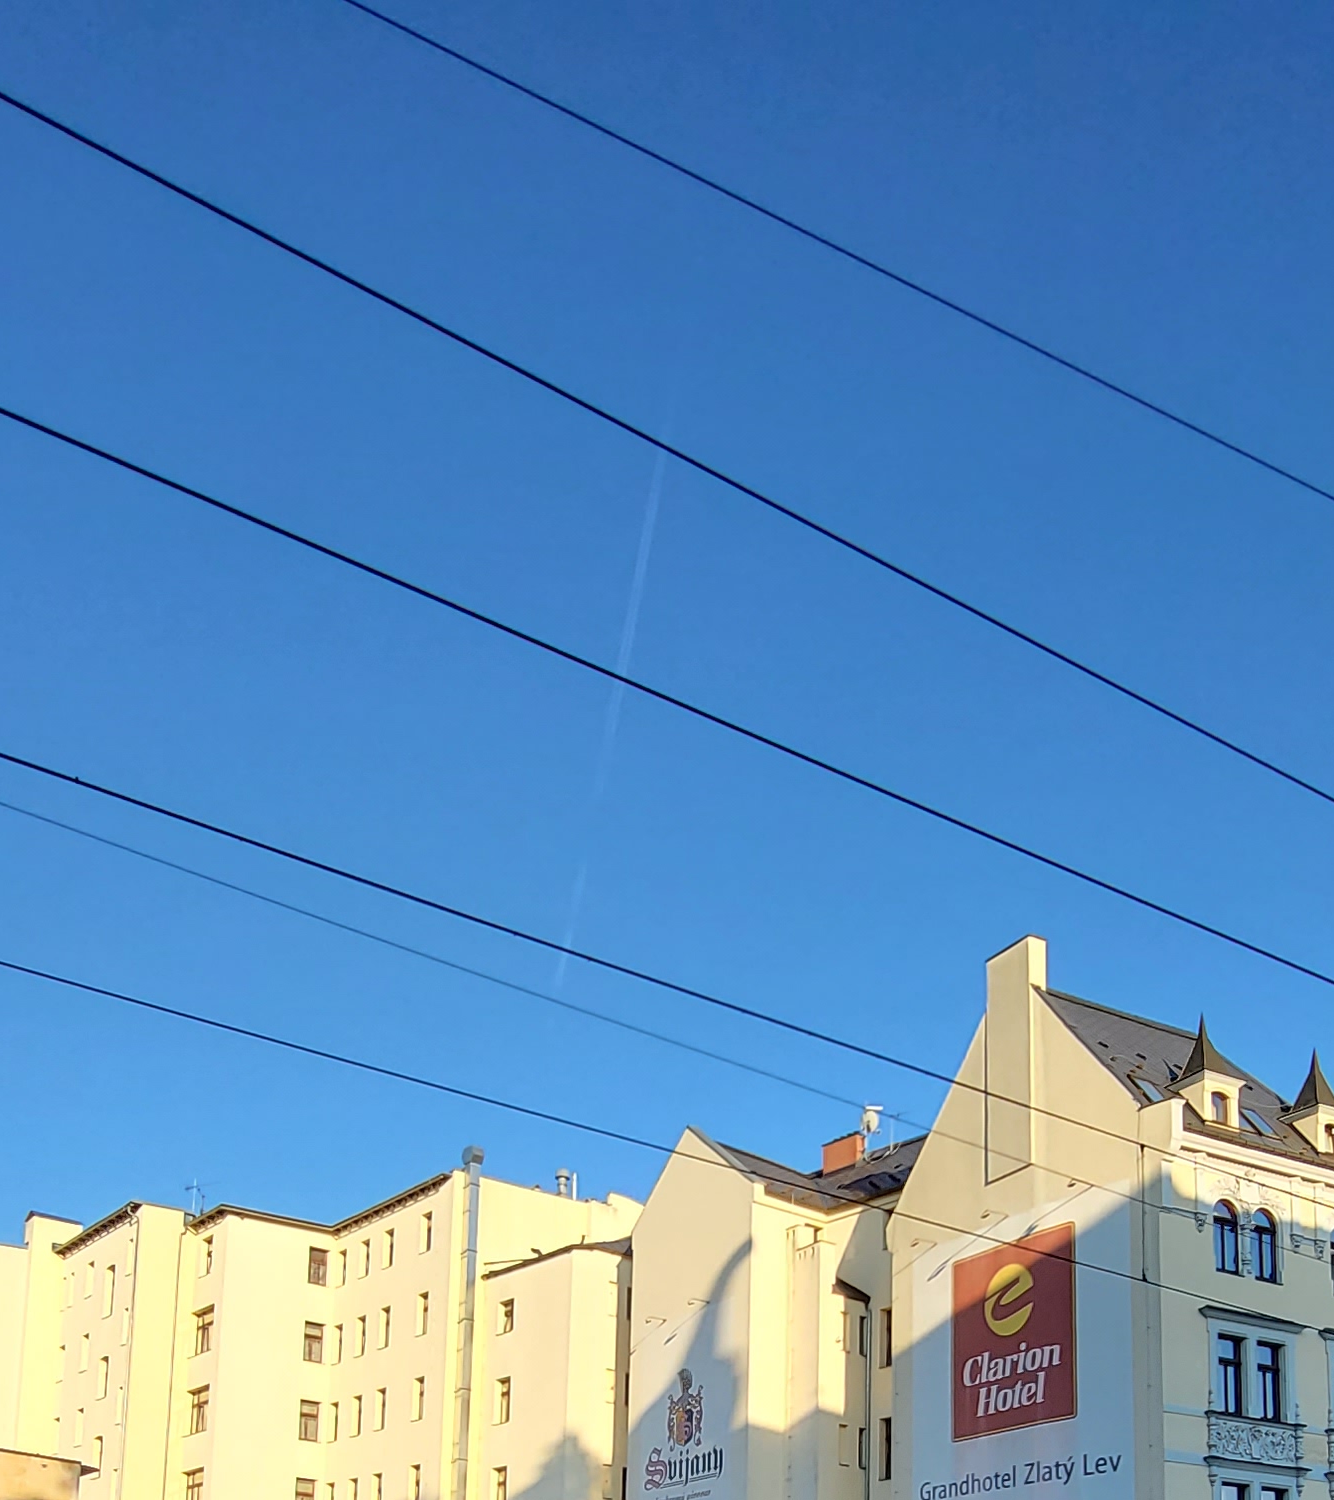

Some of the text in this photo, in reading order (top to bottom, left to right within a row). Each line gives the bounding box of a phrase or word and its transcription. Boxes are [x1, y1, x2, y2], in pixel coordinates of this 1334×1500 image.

[963, 1342, 1061, 1387] Clarion
[976, 1371, 1046, 1418] Hotel
[644, 1444, 723, 1491] Svijany
[1023, 1456, 1075, 1485] Zlatý
[1083, 1453, 1122, 1476] Lev
